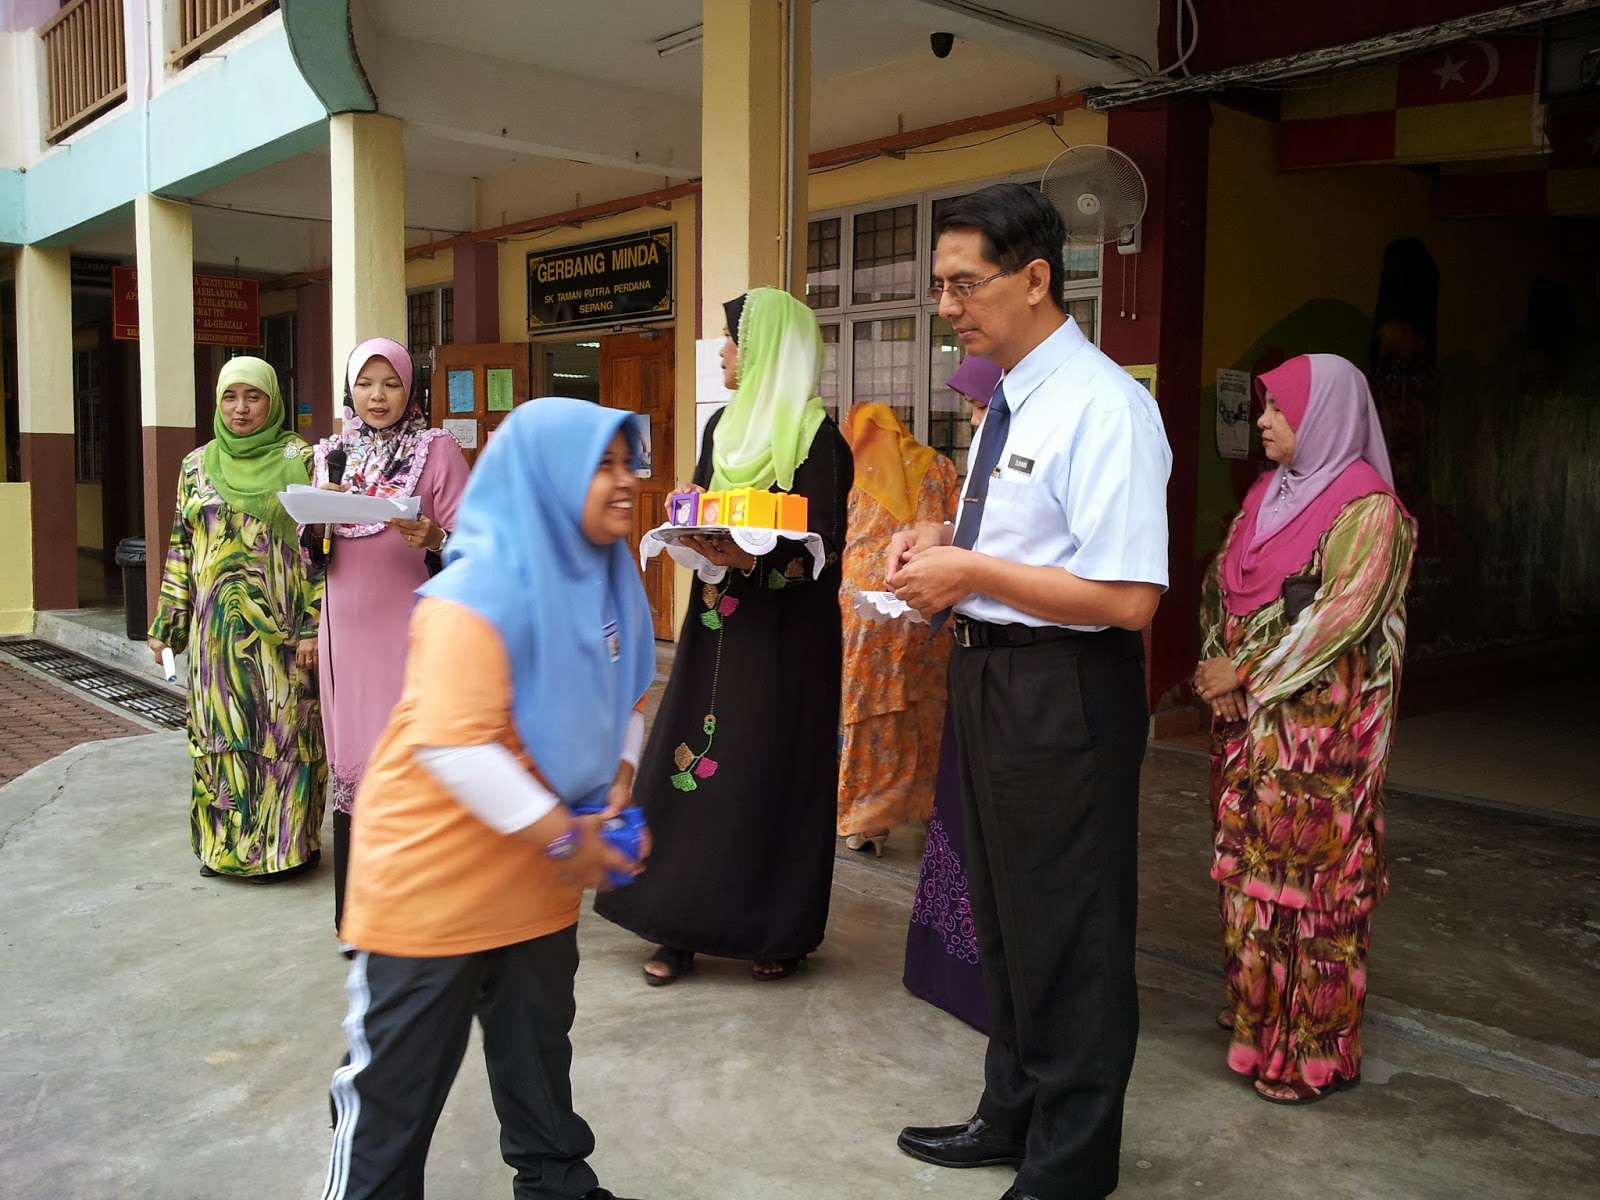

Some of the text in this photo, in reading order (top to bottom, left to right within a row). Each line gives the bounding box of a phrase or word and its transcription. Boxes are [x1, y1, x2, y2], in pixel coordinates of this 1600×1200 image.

[537, 242, 659, 283] GERBANG MINDA
[224, 280, 243, 290] UMAT
[544, 279, 652, 304] SK TAMAN PUTRA PERDANA
[579, 300, 613, 314] SEPANG
[203, 319, 243, 330] AL-GHAZALI
